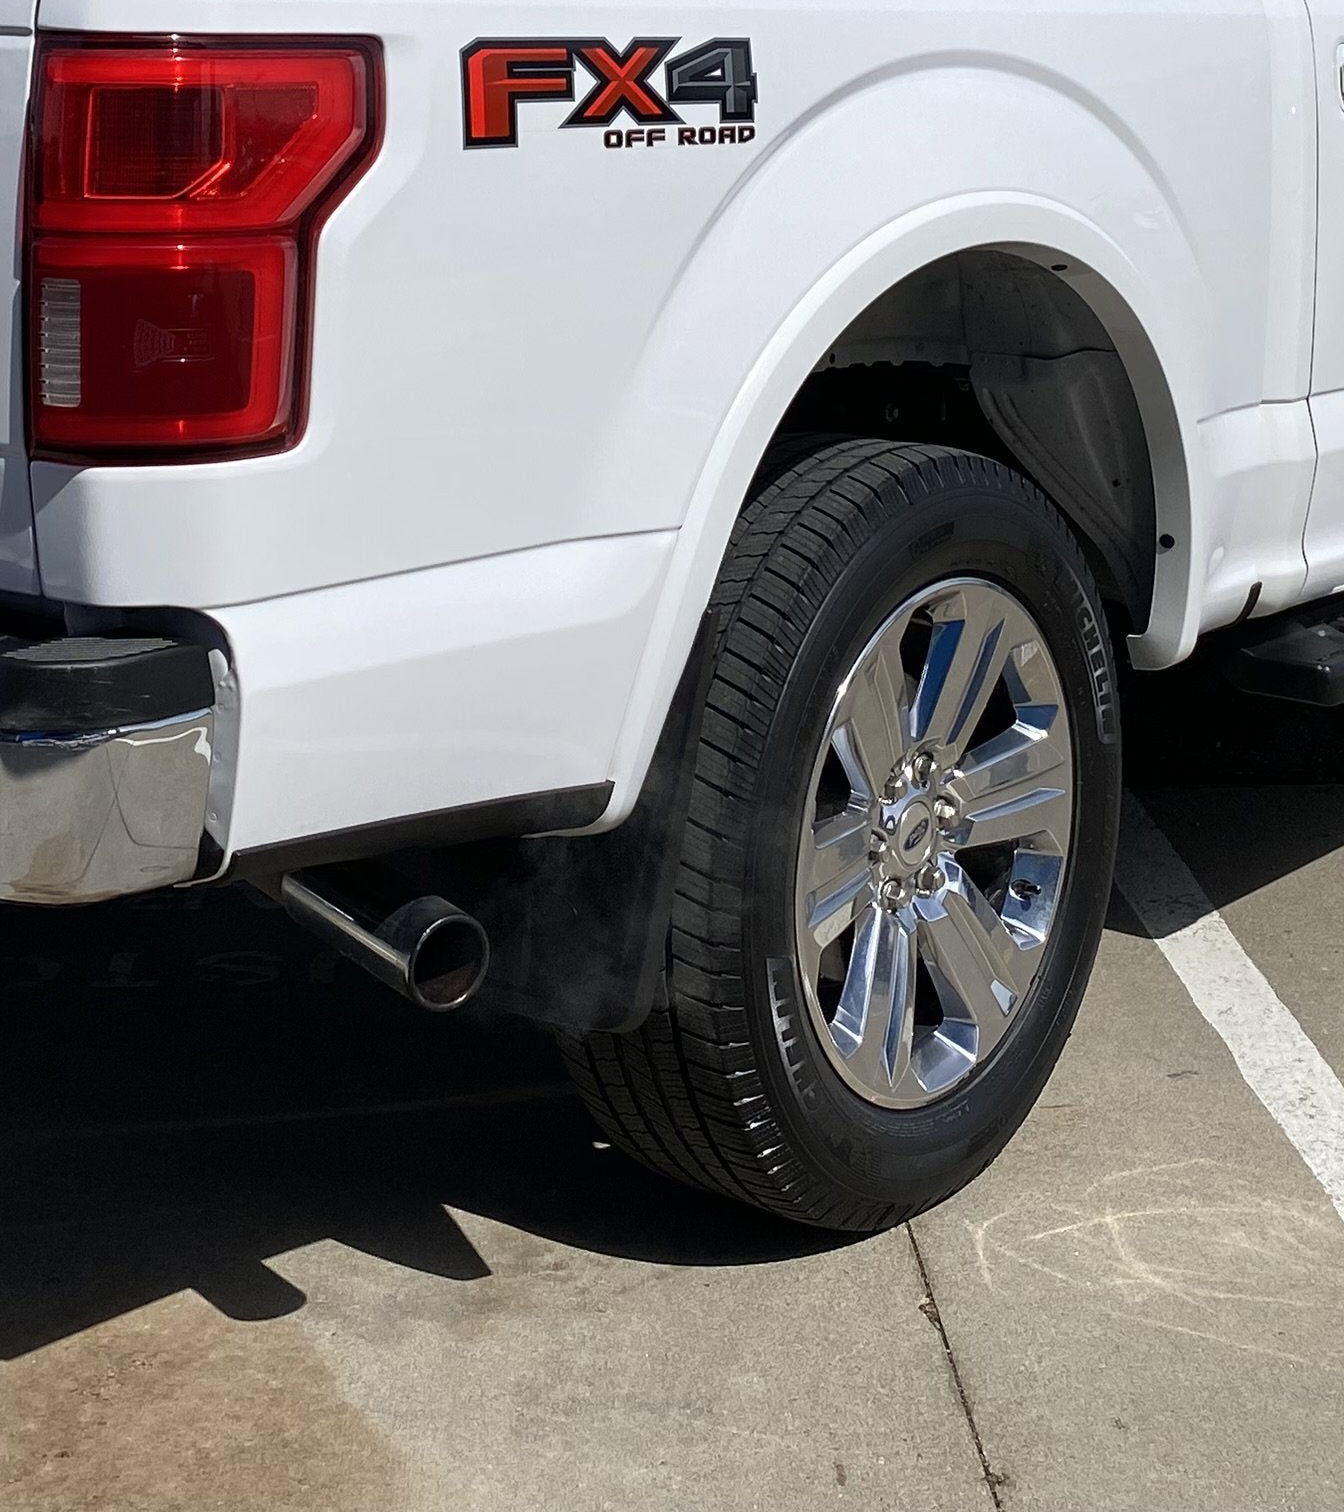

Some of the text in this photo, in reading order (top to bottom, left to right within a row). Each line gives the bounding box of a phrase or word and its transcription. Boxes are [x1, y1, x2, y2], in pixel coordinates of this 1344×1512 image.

[459, 37, 759, 150] FX4
[603, 125, 756, 149] OFF ROAD
